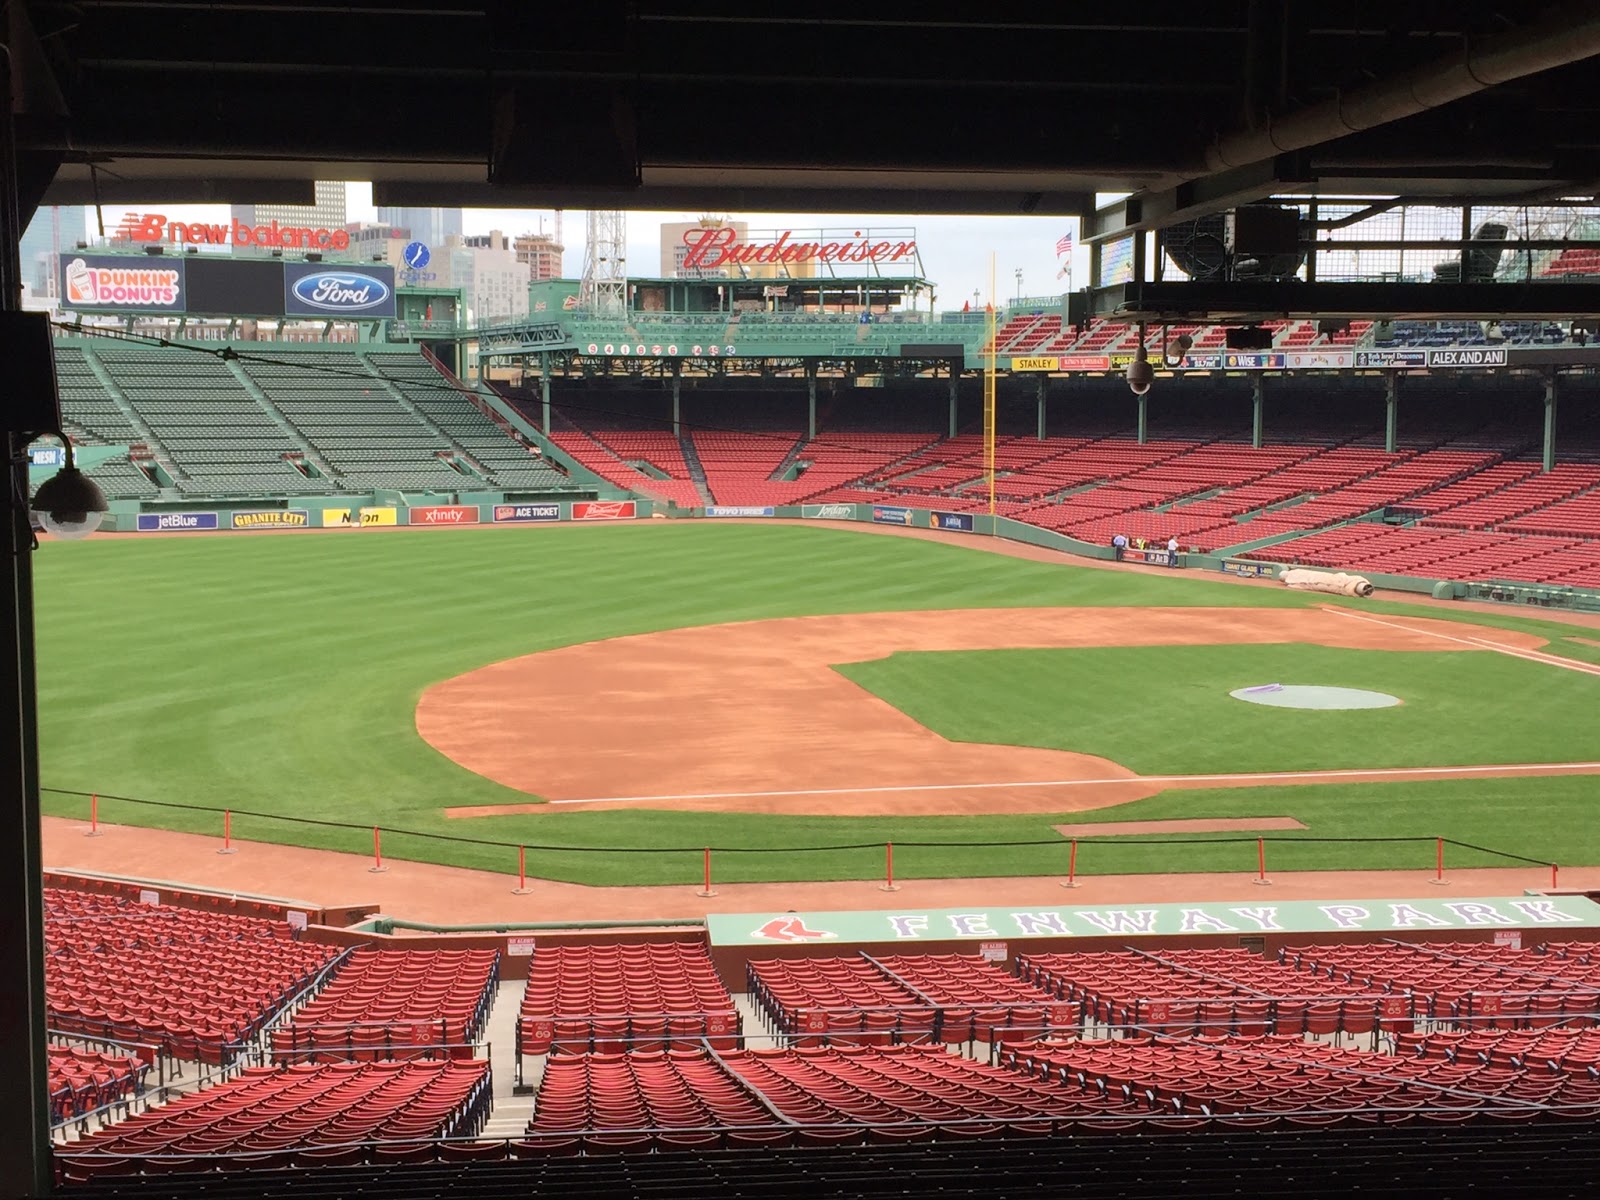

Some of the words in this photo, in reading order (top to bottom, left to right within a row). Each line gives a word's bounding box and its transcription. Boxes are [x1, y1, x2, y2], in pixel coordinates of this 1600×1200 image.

[167, 219, 230, 245] new
[231, 217, 350, 251] balance
[683, 227, 917, 269] Budweiser
[99, 271, 176, 287] DUNKIN'
[99, 286, 174, 301] DONUTS
[312, 277, 370, 304] Ford
[1020, 359, 1051, 368] STANLEY
[1432, 352, 1457, 364] ALEX
[1459, 352, 1482, 363] AND
[1484, 351, 1503, 363] ANI
[33, 450, 57, 465] NESN
[341, 512, 379, 523] Non
[425, 509, 463, 522] xfinity
[516, 508, 531, 517] ACE
[532, 507, 558, 516] TICKET
[158, 514, 198, 529] jetBlue
[234, 512, 279, 526] GRANITE
[283, 511, 305, 525] CITY
[887, 907, 1284, 937] FENWAY
[1318, 901, 1583, 929] PARK
[1387, 1006, 1401, 1015] 65
[1482, 1004, 1497, 1012] 64
[1054, 1014, 1069, 1023] 67
[1151, 1012, 1166, 1020] 66
[710, 1024, 725, 1032] 69
[810, 1021, 824, 1029] 68
[415, 1033, 430, 1041] 70
[535, 1030, 551, 1039] 69
